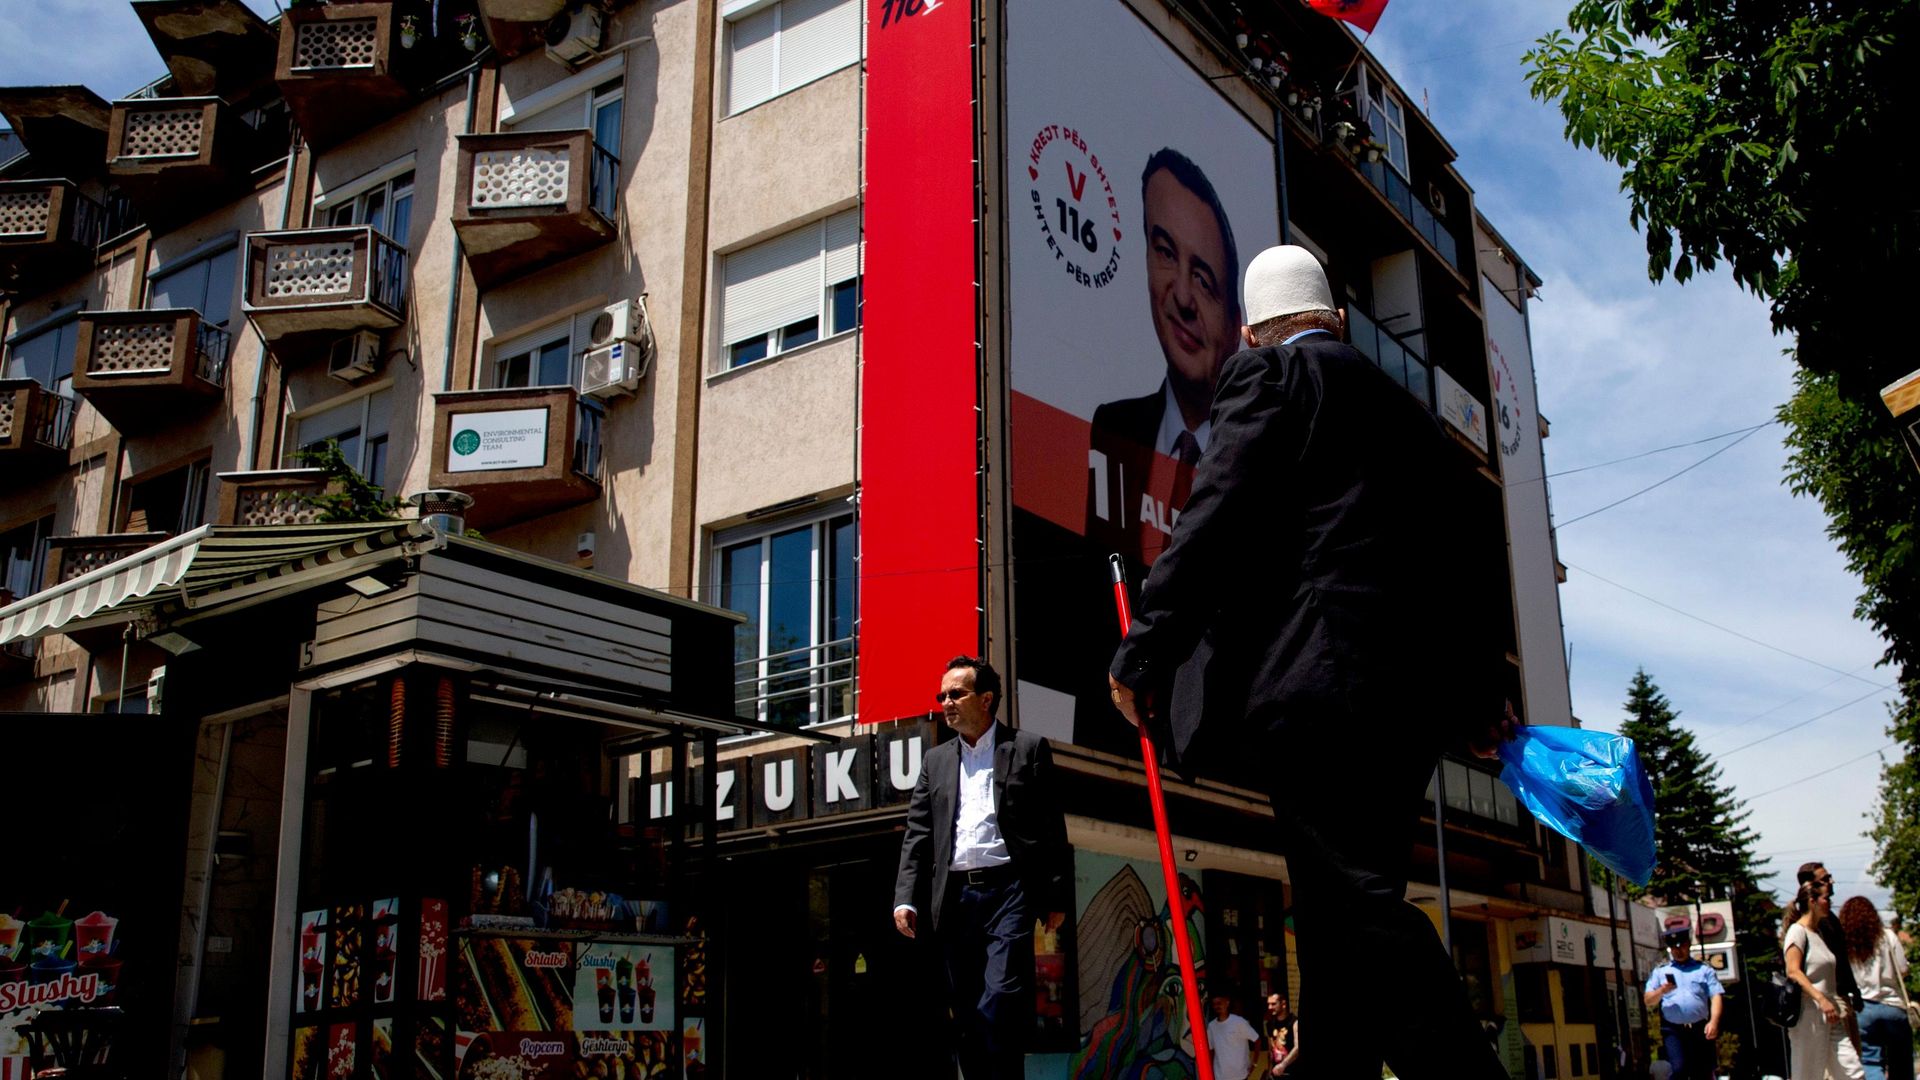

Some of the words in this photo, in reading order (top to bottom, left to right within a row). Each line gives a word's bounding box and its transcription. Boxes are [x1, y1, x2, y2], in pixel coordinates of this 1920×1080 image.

[1030, 125, 1059, 165] KREJT
[1063, 127, 1088, 155] PËR
[1090, 154, 1120, 224] SHTET
[1065, 160, 1086, 202] V
[1056, 197, 1098, 253] 116
[1031, 189, 1064, 261] SHTET
[1066, 260, 1091, 288] PËR
[1094, 246, 1121, 288] KREJT
[482, 436, 526, 445] CONSULTING
[483, 428, 542, 437] ENVIRONMENTAL
[482, 444, 503, 452] TEAM
[1088, 449, 1109, 522] 1
[304, 641, 313, 666] 5
[583, 954, 617, 972] Slushy
[0, 972, 98, 1013] Slushy
[521, 1037, 564, 1059] Popcorn
[582, 1038, 628, 1057] Gështenja
